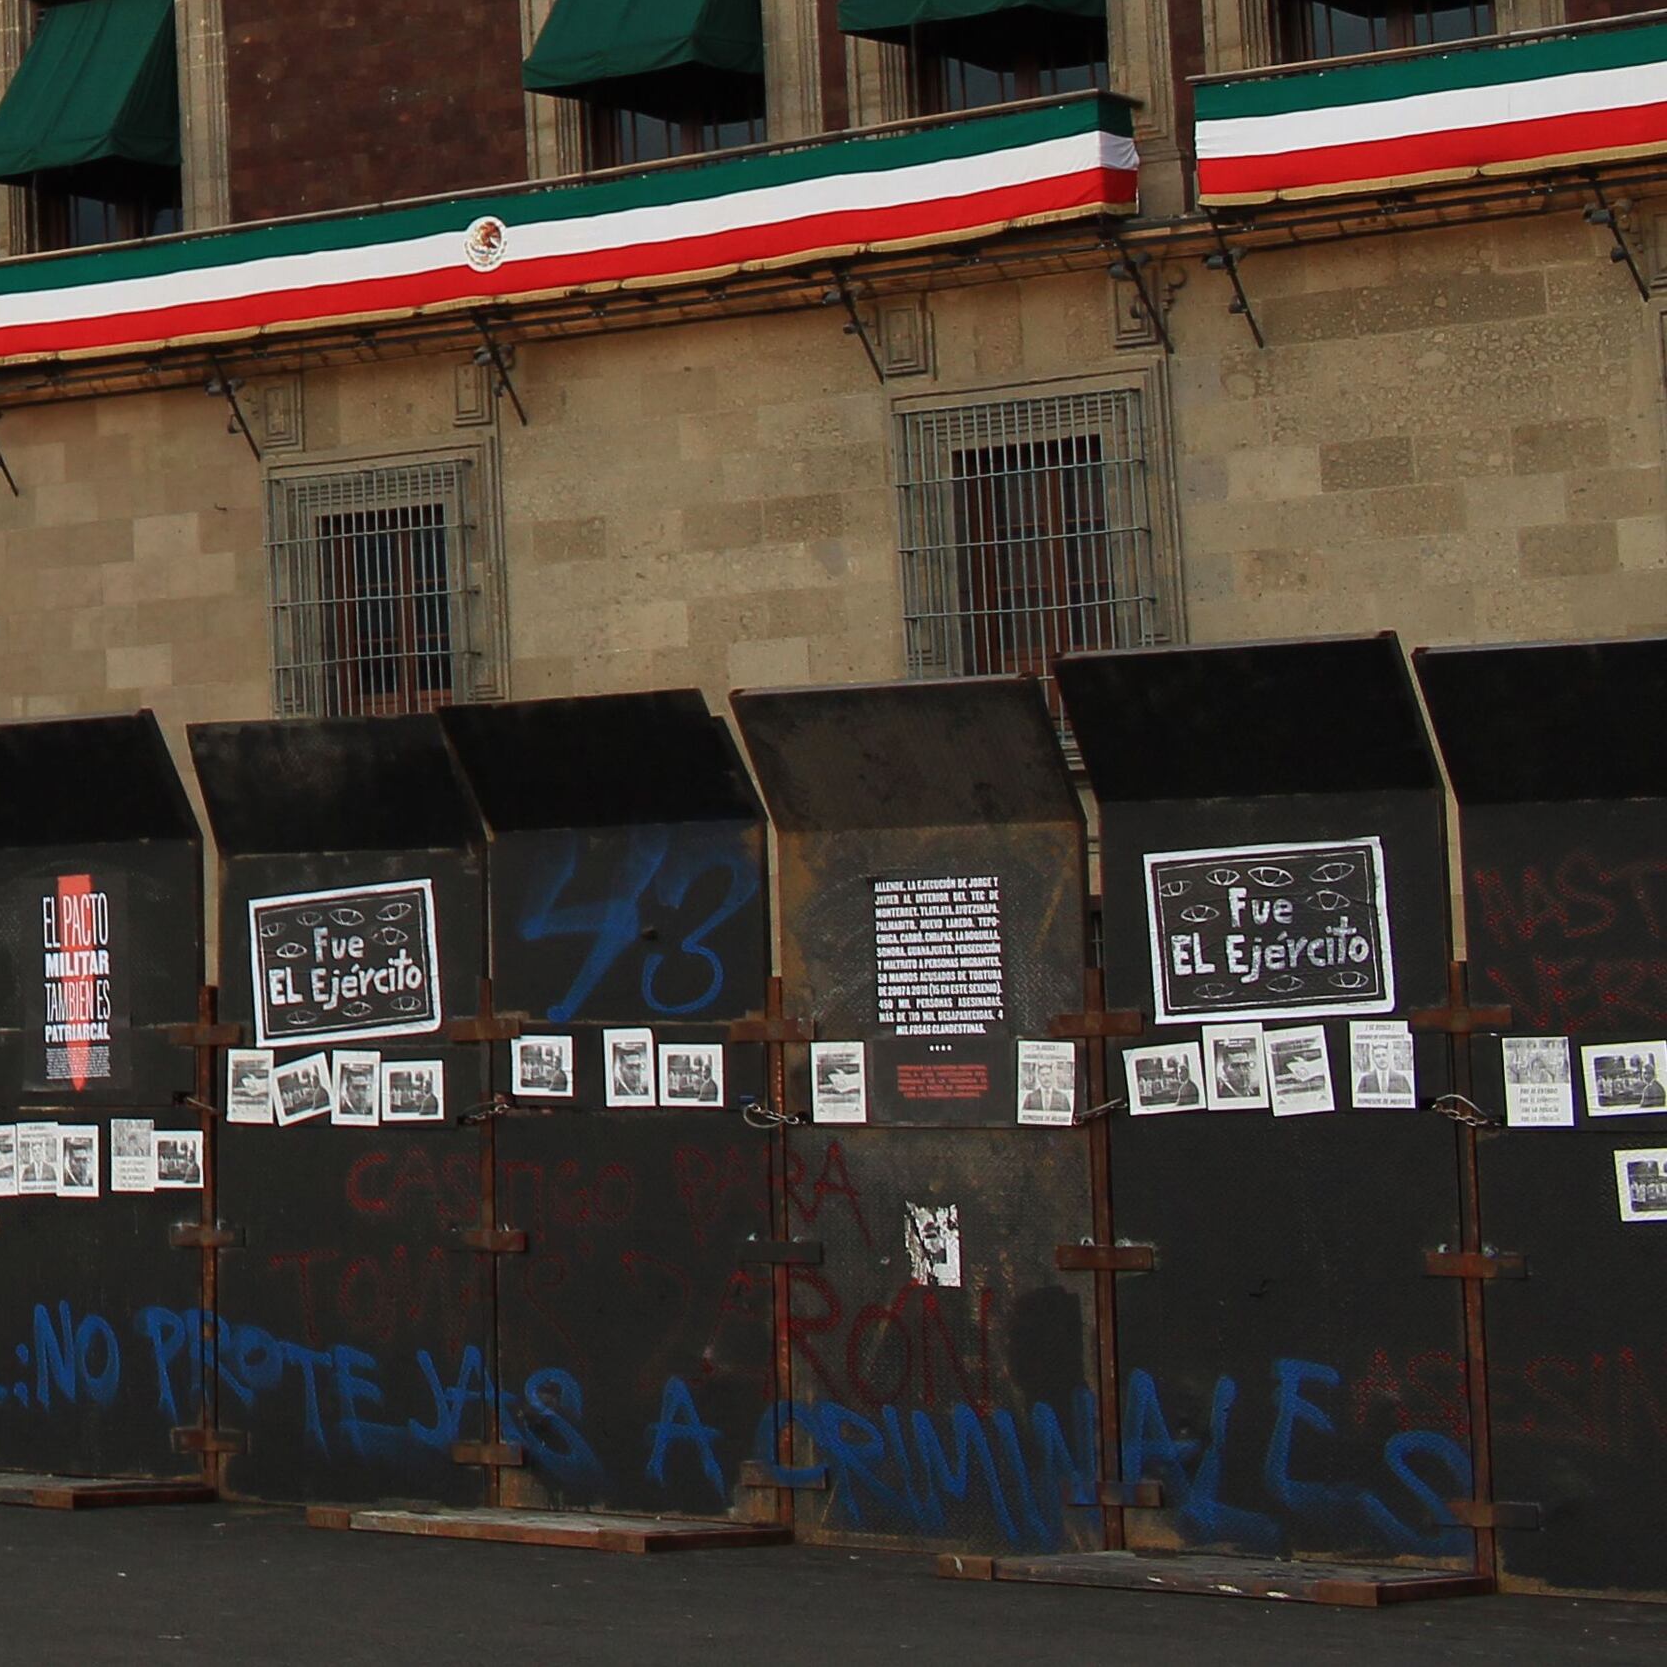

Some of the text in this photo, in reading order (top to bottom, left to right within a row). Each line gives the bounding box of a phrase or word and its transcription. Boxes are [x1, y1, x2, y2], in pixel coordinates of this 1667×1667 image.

[43, 892, 108, 948] EL PACTO
[517, 828, 759, 1022] 43
[1228, 887, 1293, 928] Fue
[45, 950, 109, 978] MILITAR
[313, 927, 365, 963] Fue
[1171, 916, 1370, 983] EL Ejército
[44, 975, 110, 1022] TAMBIÉN ES
[268, 948, 422, 1010] EL Ejército
[45, 1023, 111, 1043] PATRIARCAL
[645, 1374, 726, 1500] A
[757, 1357, 1472, 1555] CRIMINALES
